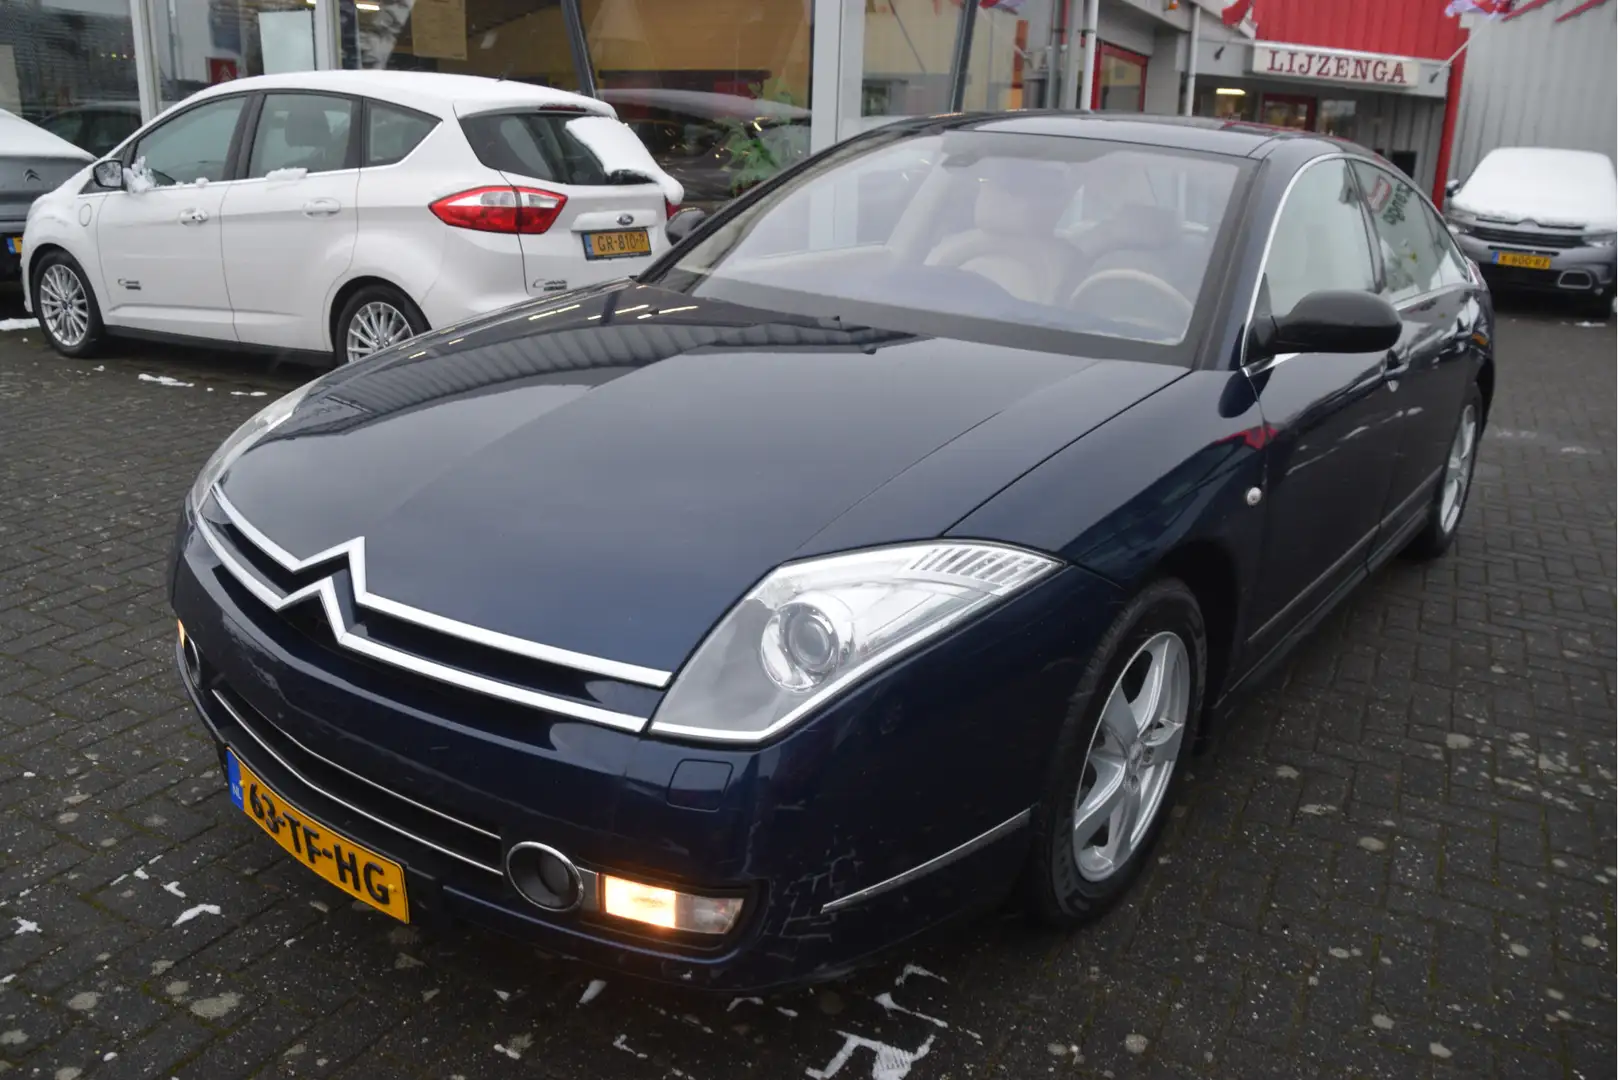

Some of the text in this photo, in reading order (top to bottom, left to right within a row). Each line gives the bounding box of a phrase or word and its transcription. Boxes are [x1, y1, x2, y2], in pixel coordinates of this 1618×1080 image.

[1267, 50, 1407, 84] LIJZENGA
[231, 782, 242, 800] NL
[250, 783, 390, 905] 63-TF-HG
